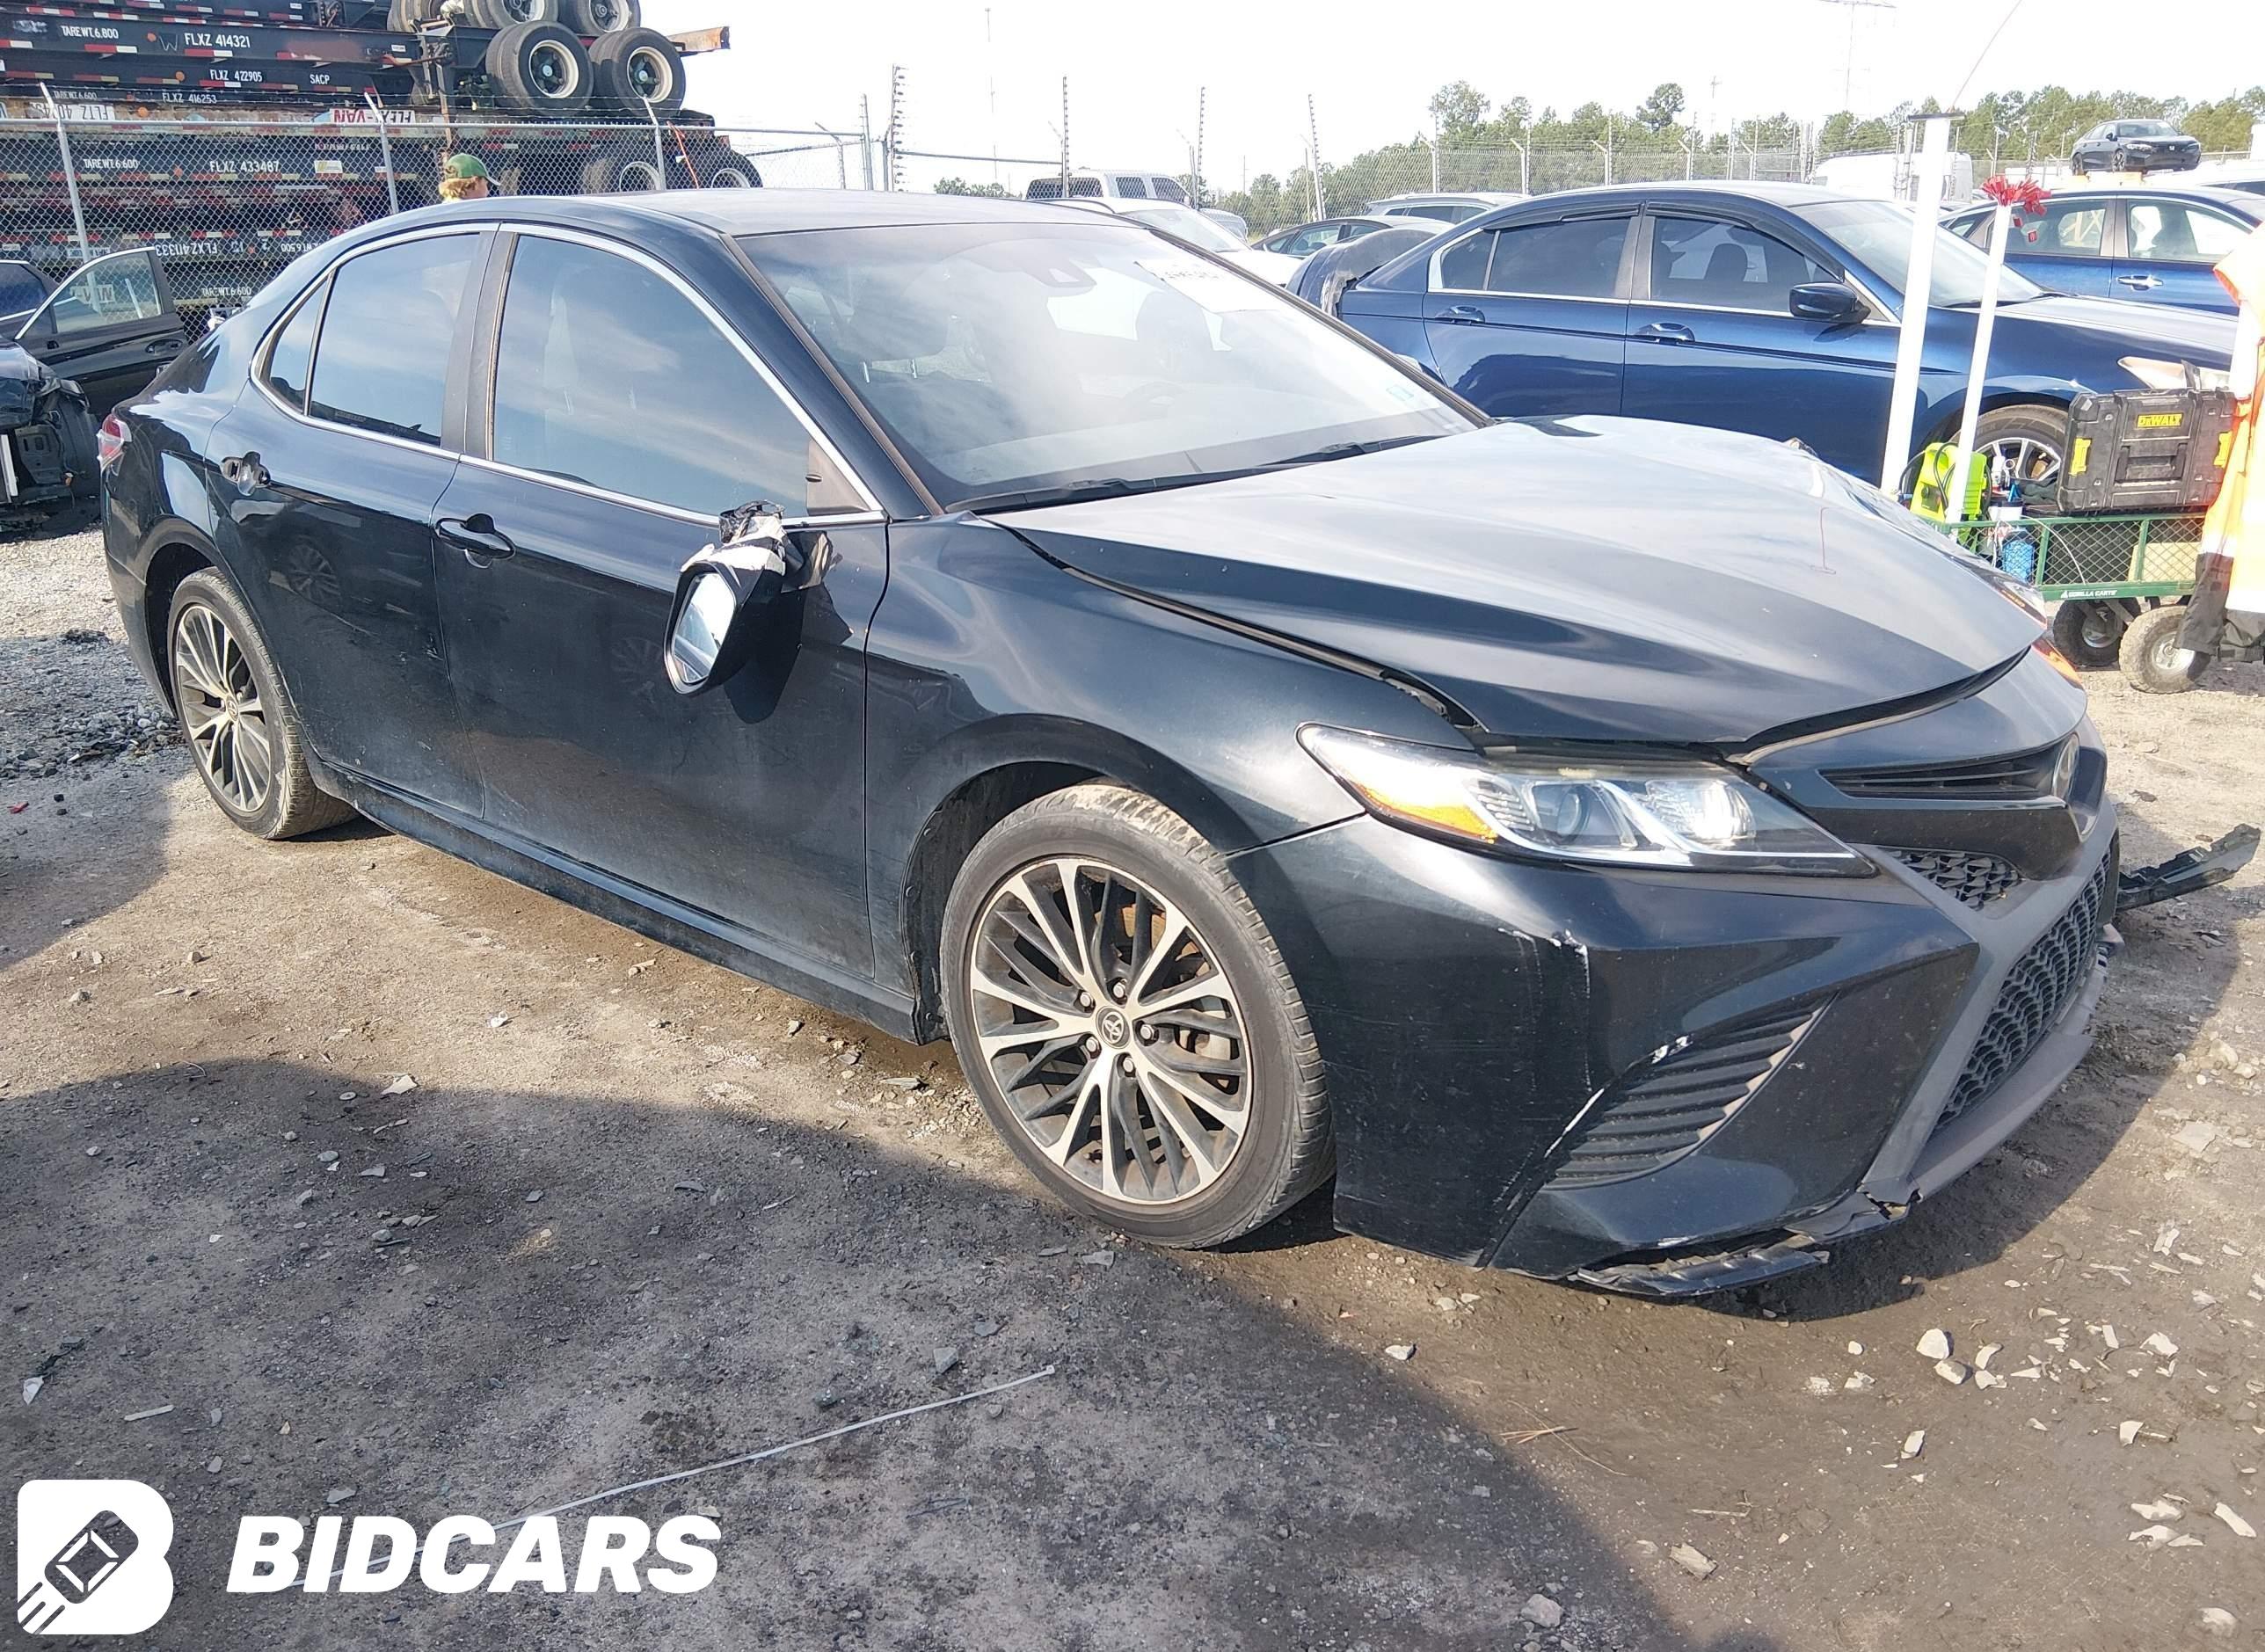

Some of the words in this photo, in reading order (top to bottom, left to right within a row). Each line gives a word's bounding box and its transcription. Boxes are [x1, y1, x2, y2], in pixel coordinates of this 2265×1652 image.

[184, 33, 213, 47] FLXZ
[215, 34, 251, 47] 414321
[210, 69, 229, 80] FLXZ
[235, 70, 263, 83] 422905
[310, 74, 331, 85] SACP
[162, 92, 185, 104] FLXZ
[188, 94, 218, 105] 416253
[209, 160, 236, 173] FLXZ
[240, 160, 280, 173] 433487
